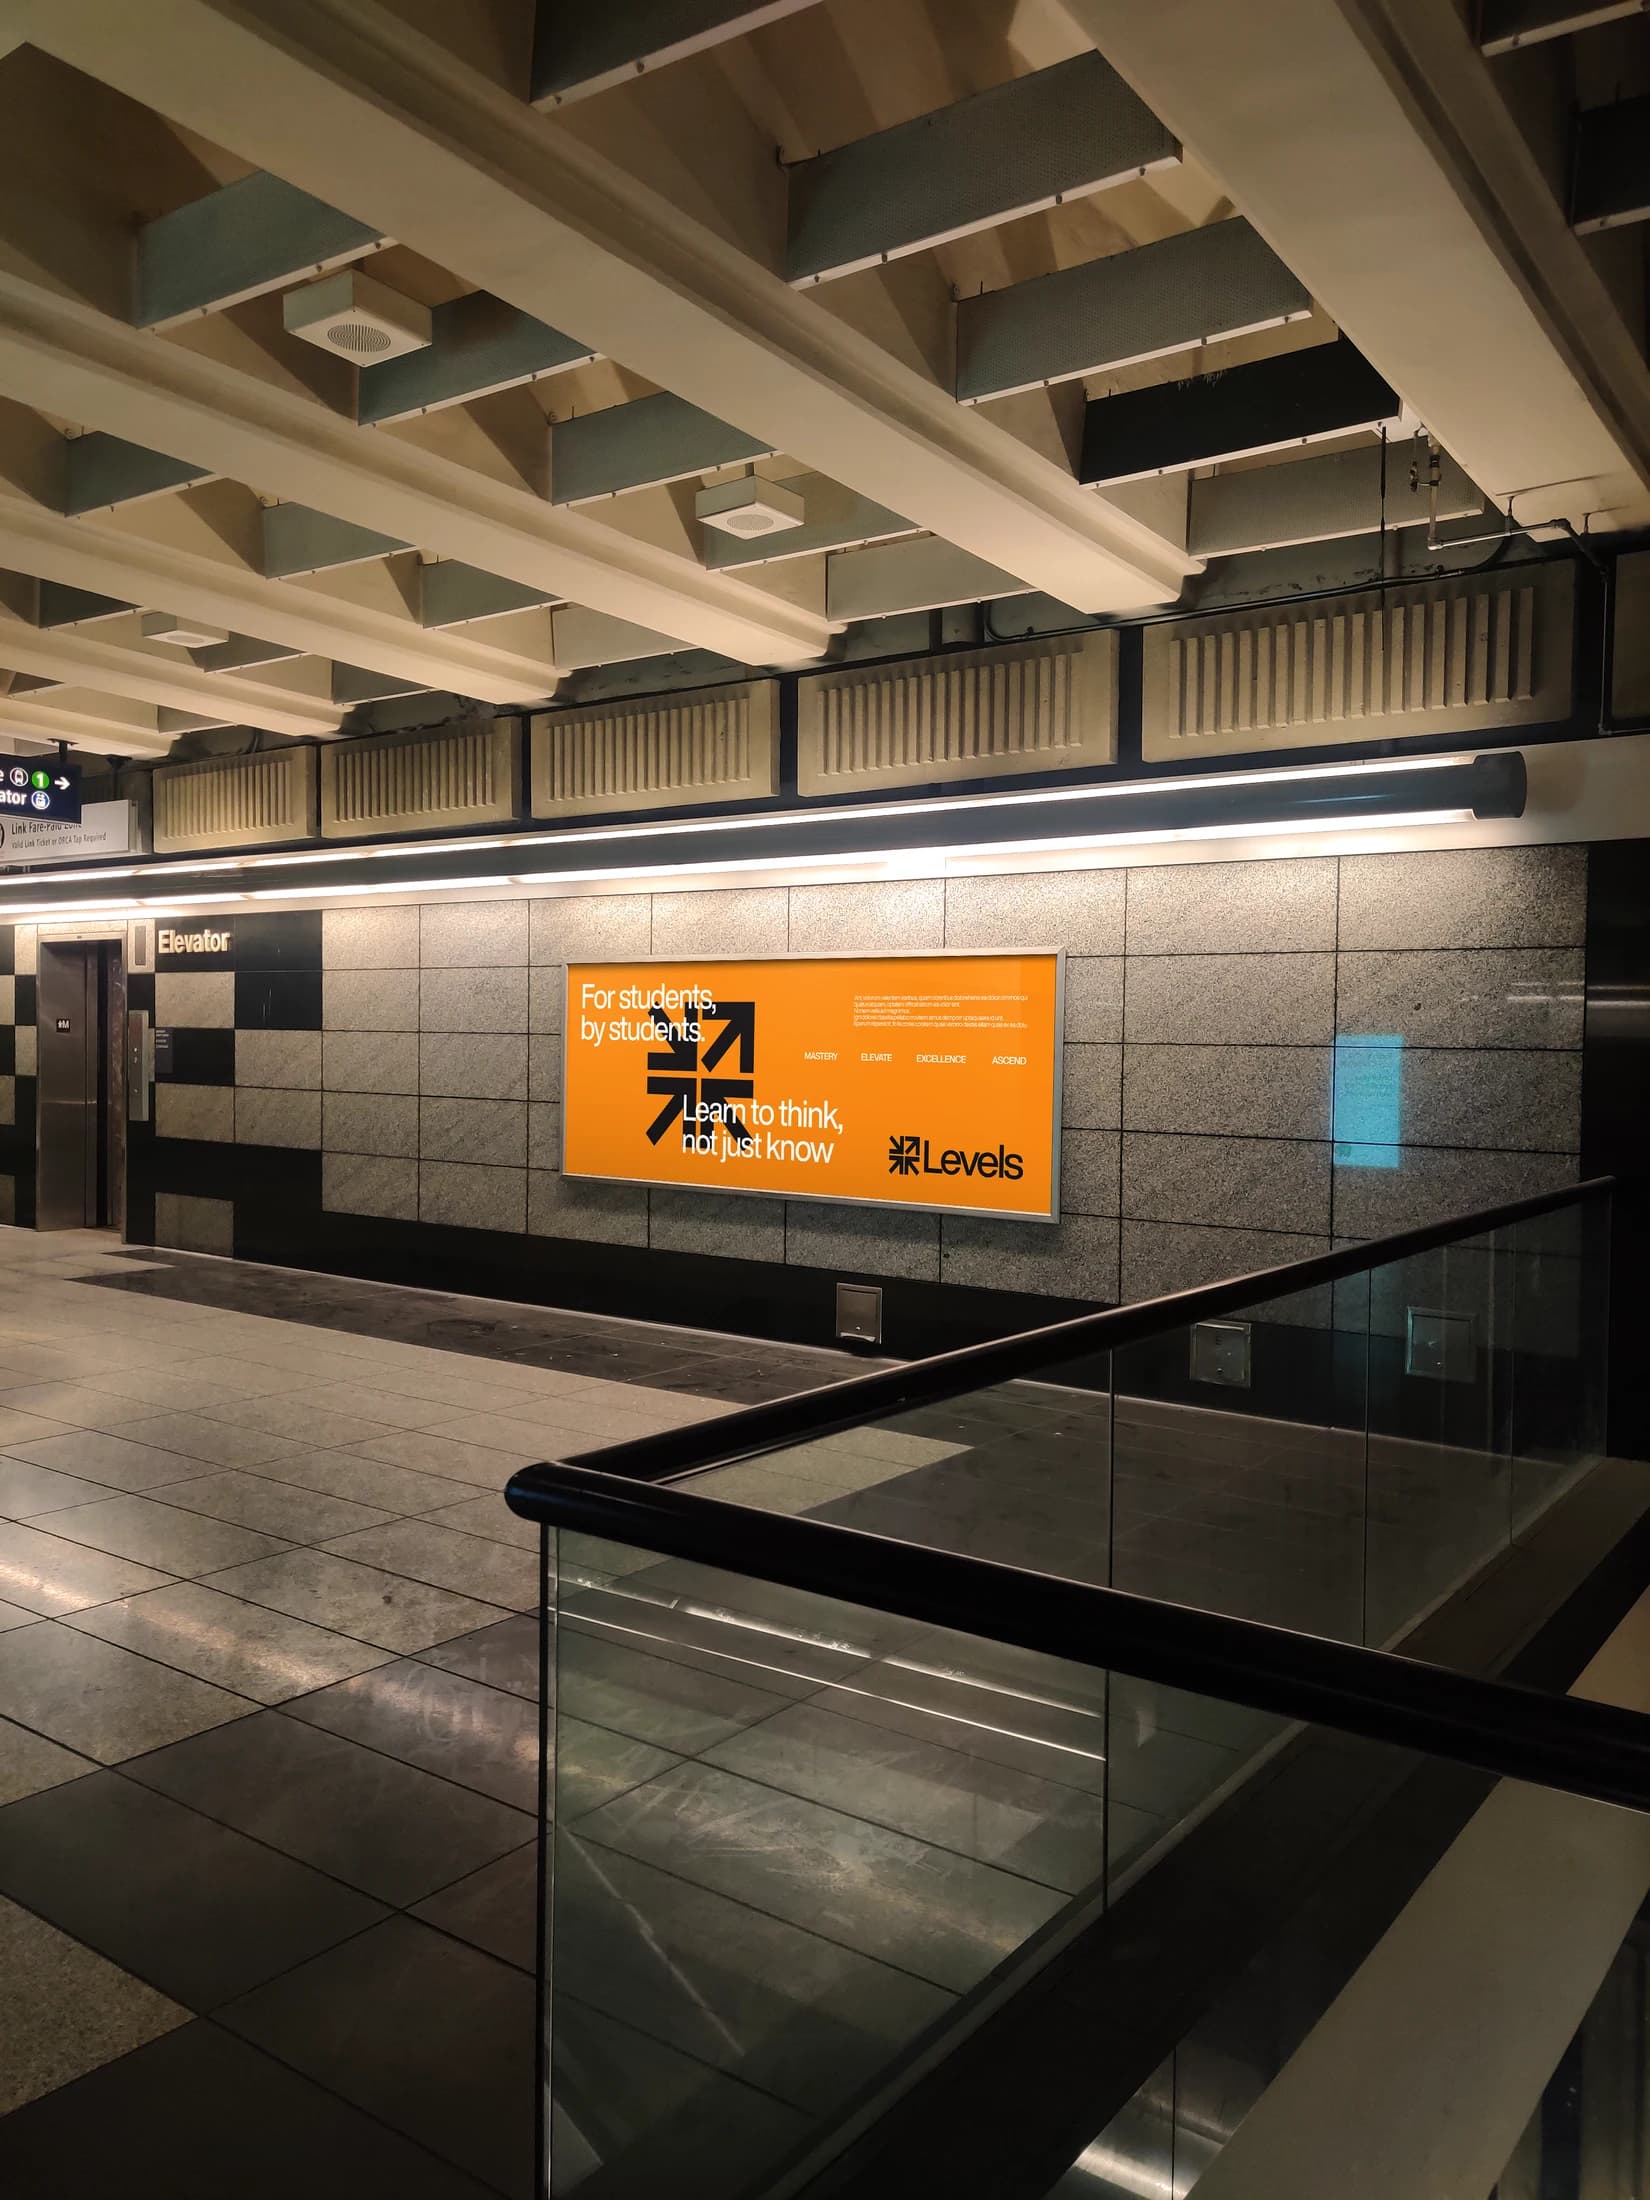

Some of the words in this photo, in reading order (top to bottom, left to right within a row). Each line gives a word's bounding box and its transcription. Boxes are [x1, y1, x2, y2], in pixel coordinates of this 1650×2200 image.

[11, 822, 27, 835] Link
[24, 839, 35, 848] Link
[36, 838, 50, 847] Ticket
[58, 835, 72, 845] ORCA
[73, 834, 82, 845] Tap
[83, 832, 107, 843] Required
[158, 929, 231, 953] Elevator
[582, 983, 616, 1009] For
[619, 983, 716, 1015] students,
[581, 1015, 606, 1047] by
[609, 1015, 705, 1042] students.
[804, 1052, 838, 1061] MASTERY
[860, 1052, 893, 1062] ELEVATE
[916, 1054, 967, 1064] EXCELLENCE
[991, 1056, 1027, 1065] ASCEND
[683, 1094, 746, 1124] Learn
[751, 1099, 774, 1126] to
[778, 1099, 843, 1135] think,
[682, 1130, 718, 1156] not
[720, 1131, 762, 1163] just
[767, 1132, 834, 1163] know
[923, 1140, 1024, 1180] Levels
